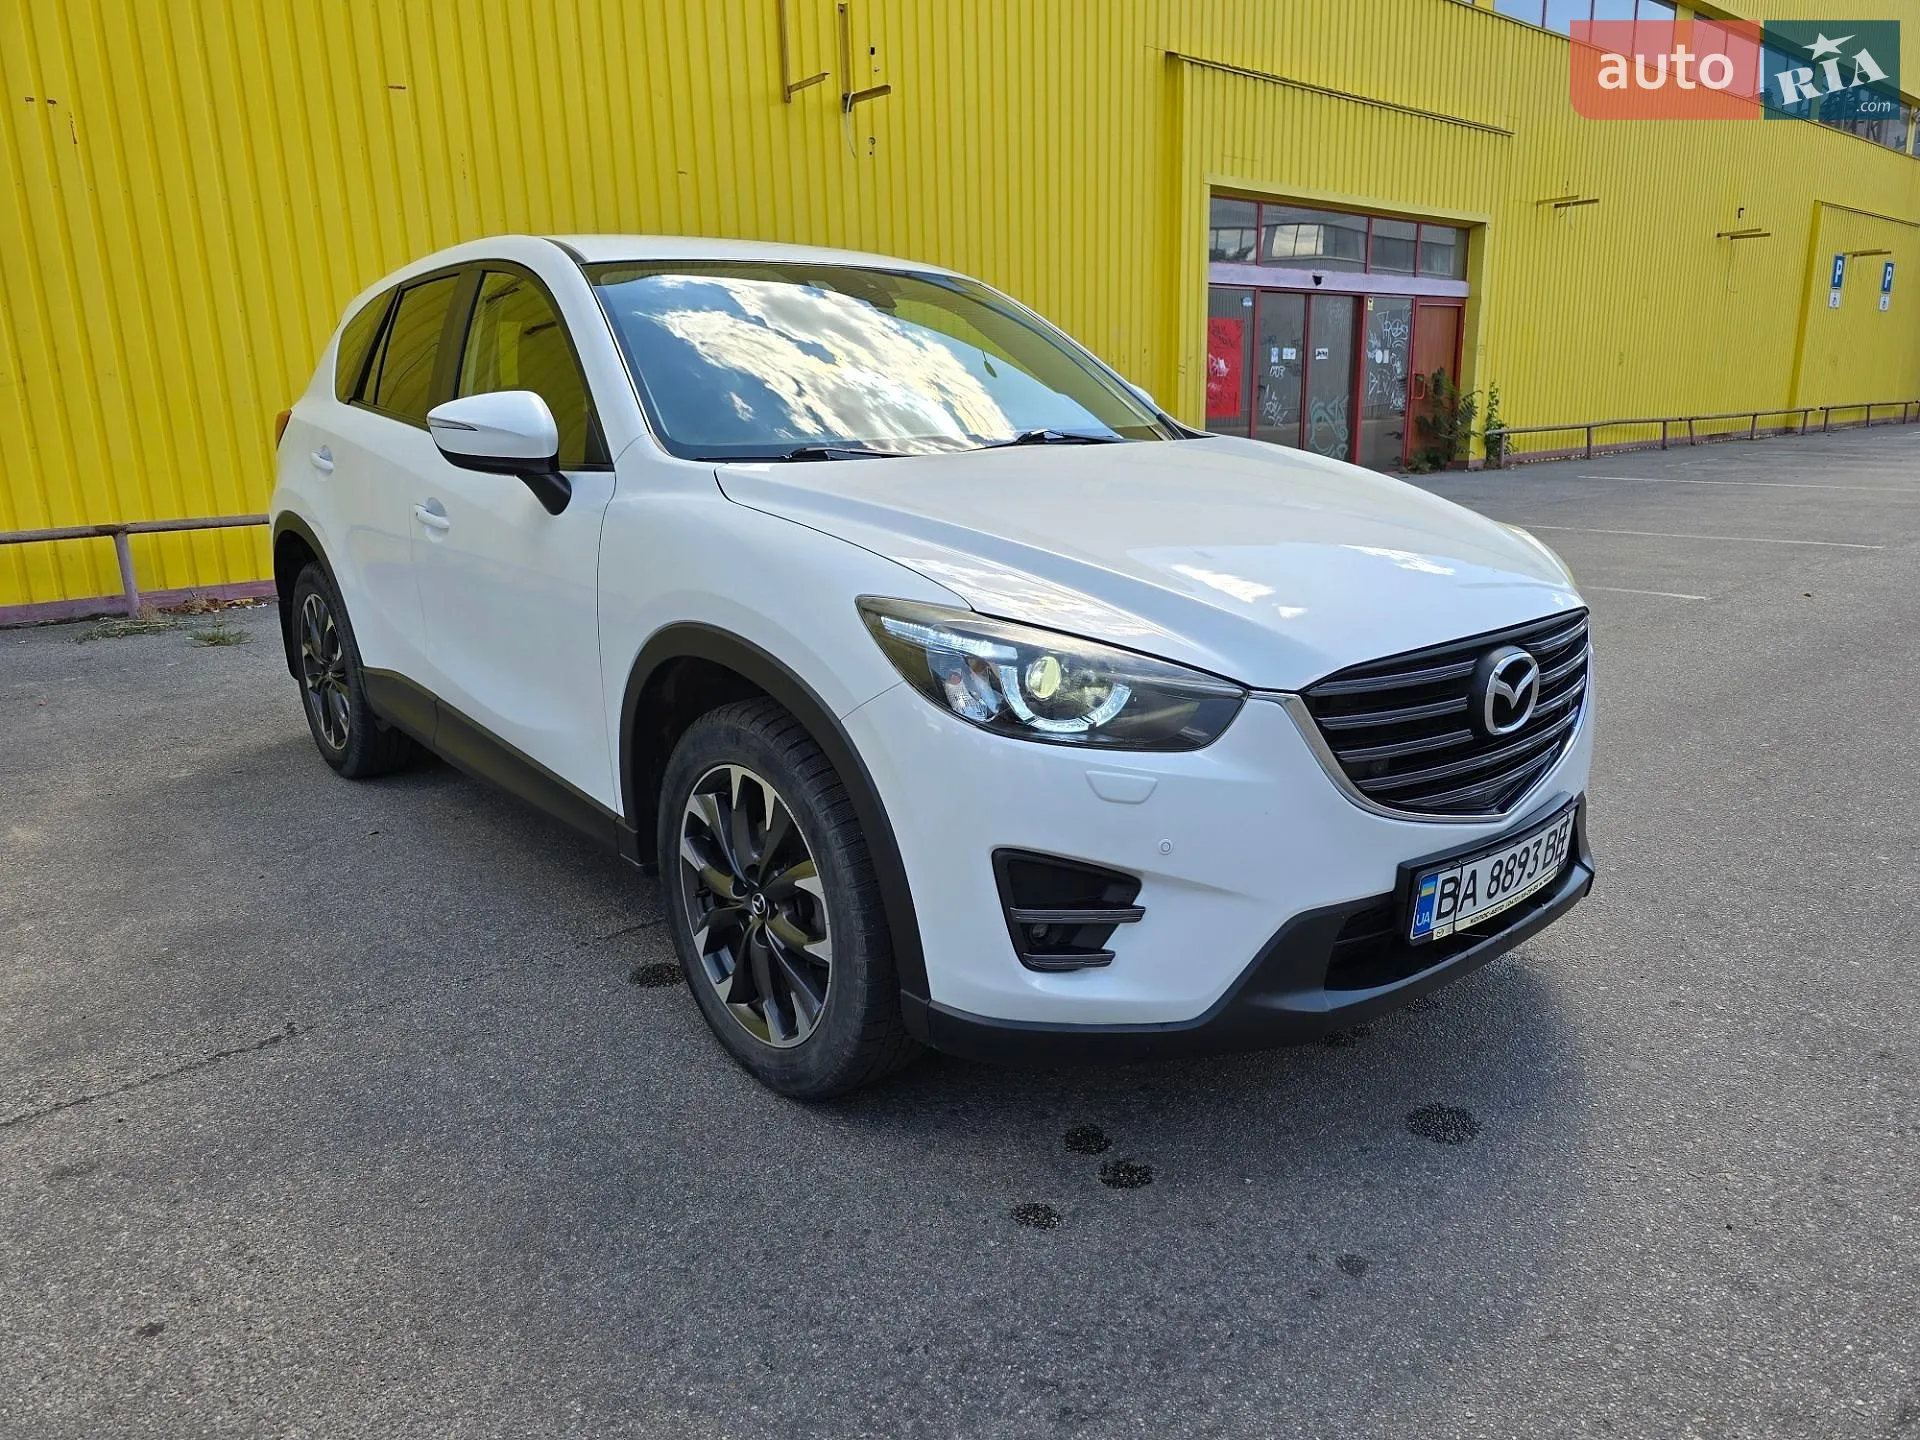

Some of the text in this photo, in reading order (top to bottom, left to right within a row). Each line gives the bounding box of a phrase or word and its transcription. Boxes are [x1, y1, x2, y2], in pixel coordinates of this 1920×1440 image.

[1834, 259, 1843, 284] P
[1884, 266, 1893, 289] P
[1436, 869, 1477, 921] BA
[1487, 838, 1543, 899] 8893
[1416, 911, 1431, 926] UA
